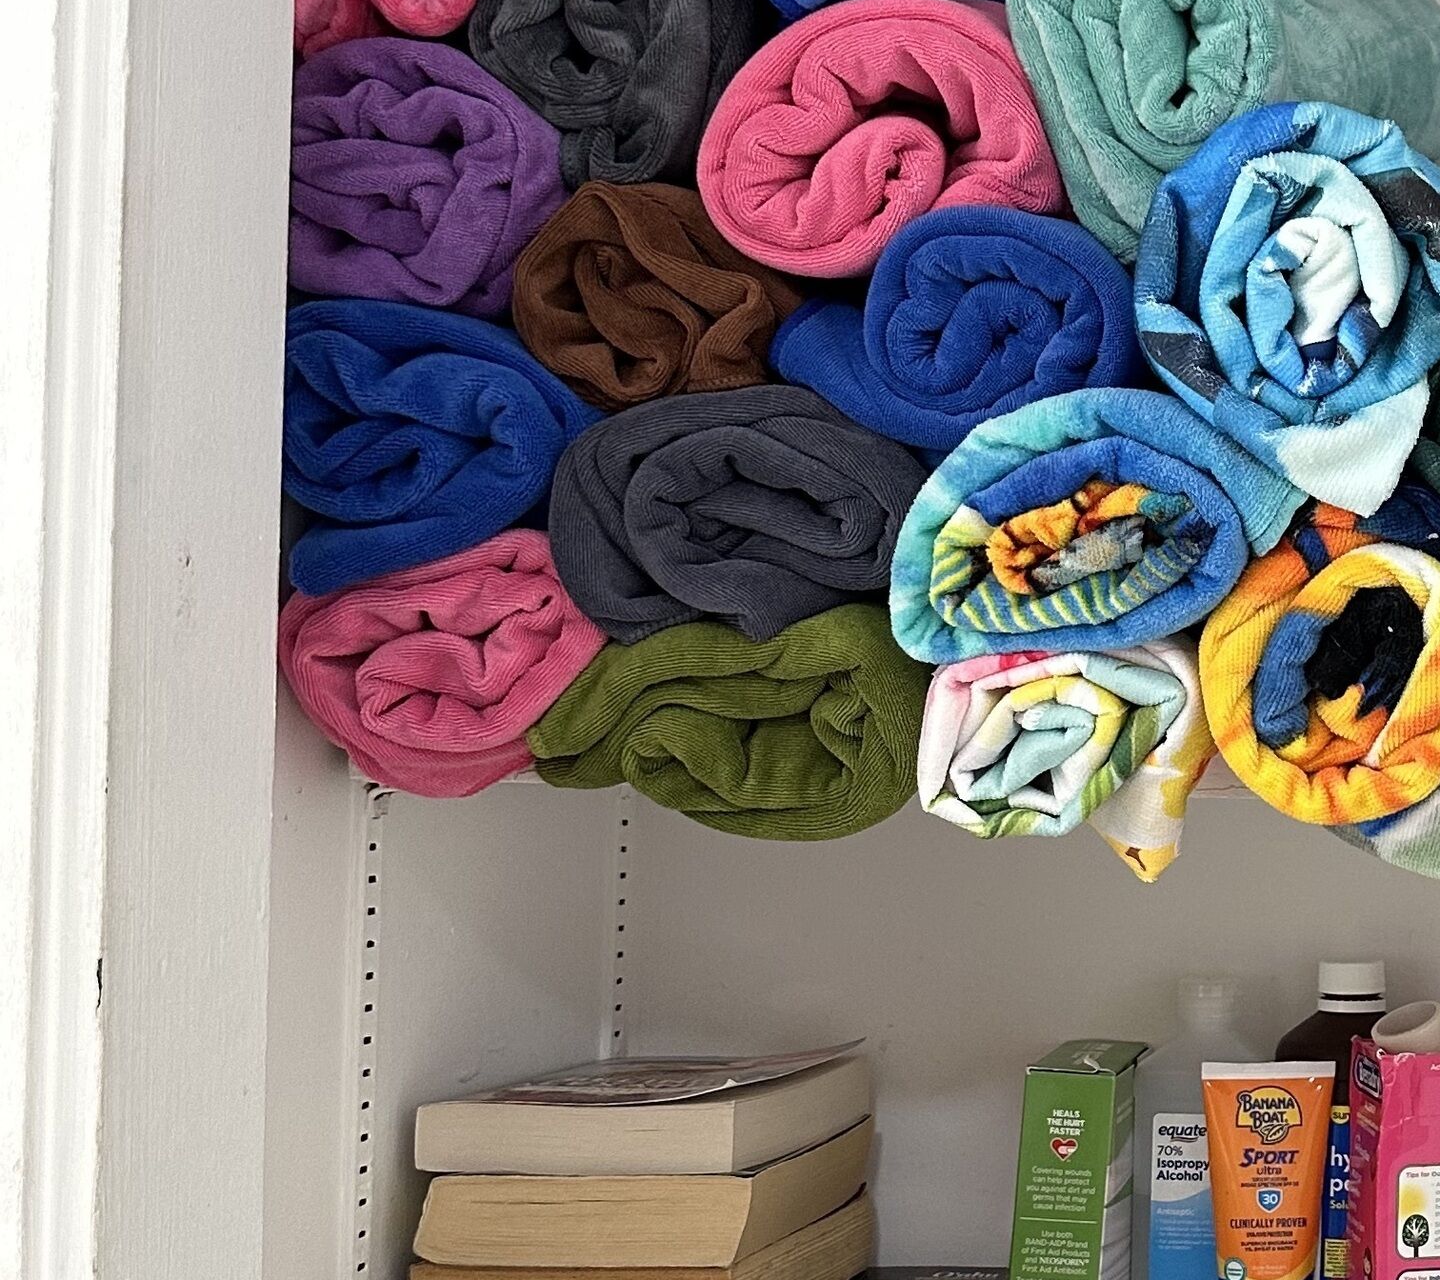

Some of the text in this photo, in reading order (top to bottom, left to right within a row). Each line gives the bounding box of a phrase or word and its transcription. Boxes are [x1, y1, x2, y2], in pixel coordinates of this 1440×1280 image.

[1240, 1093, 1296, 1112] BANANA
[1052, 1109, 1080, 1118] HEALS
[1047, 1118, 1086, 1128] THE HURT
[1158, 1124, 1207, 1140] equate
[1157, 1145, 1183, 1156] 70%
[1239, 1147, 1299, 1168] SPORT
[1156, 1158, 1210, 1172] Isopropy
[1256, 1166, 1282, 1175] ultra
[1156, 1170, 1203, 1182] Alcohol
[1261, 1193, 1279, 1205] 30
[1230, 1217, 1307, 1229] CLINICALLY PROVEN
